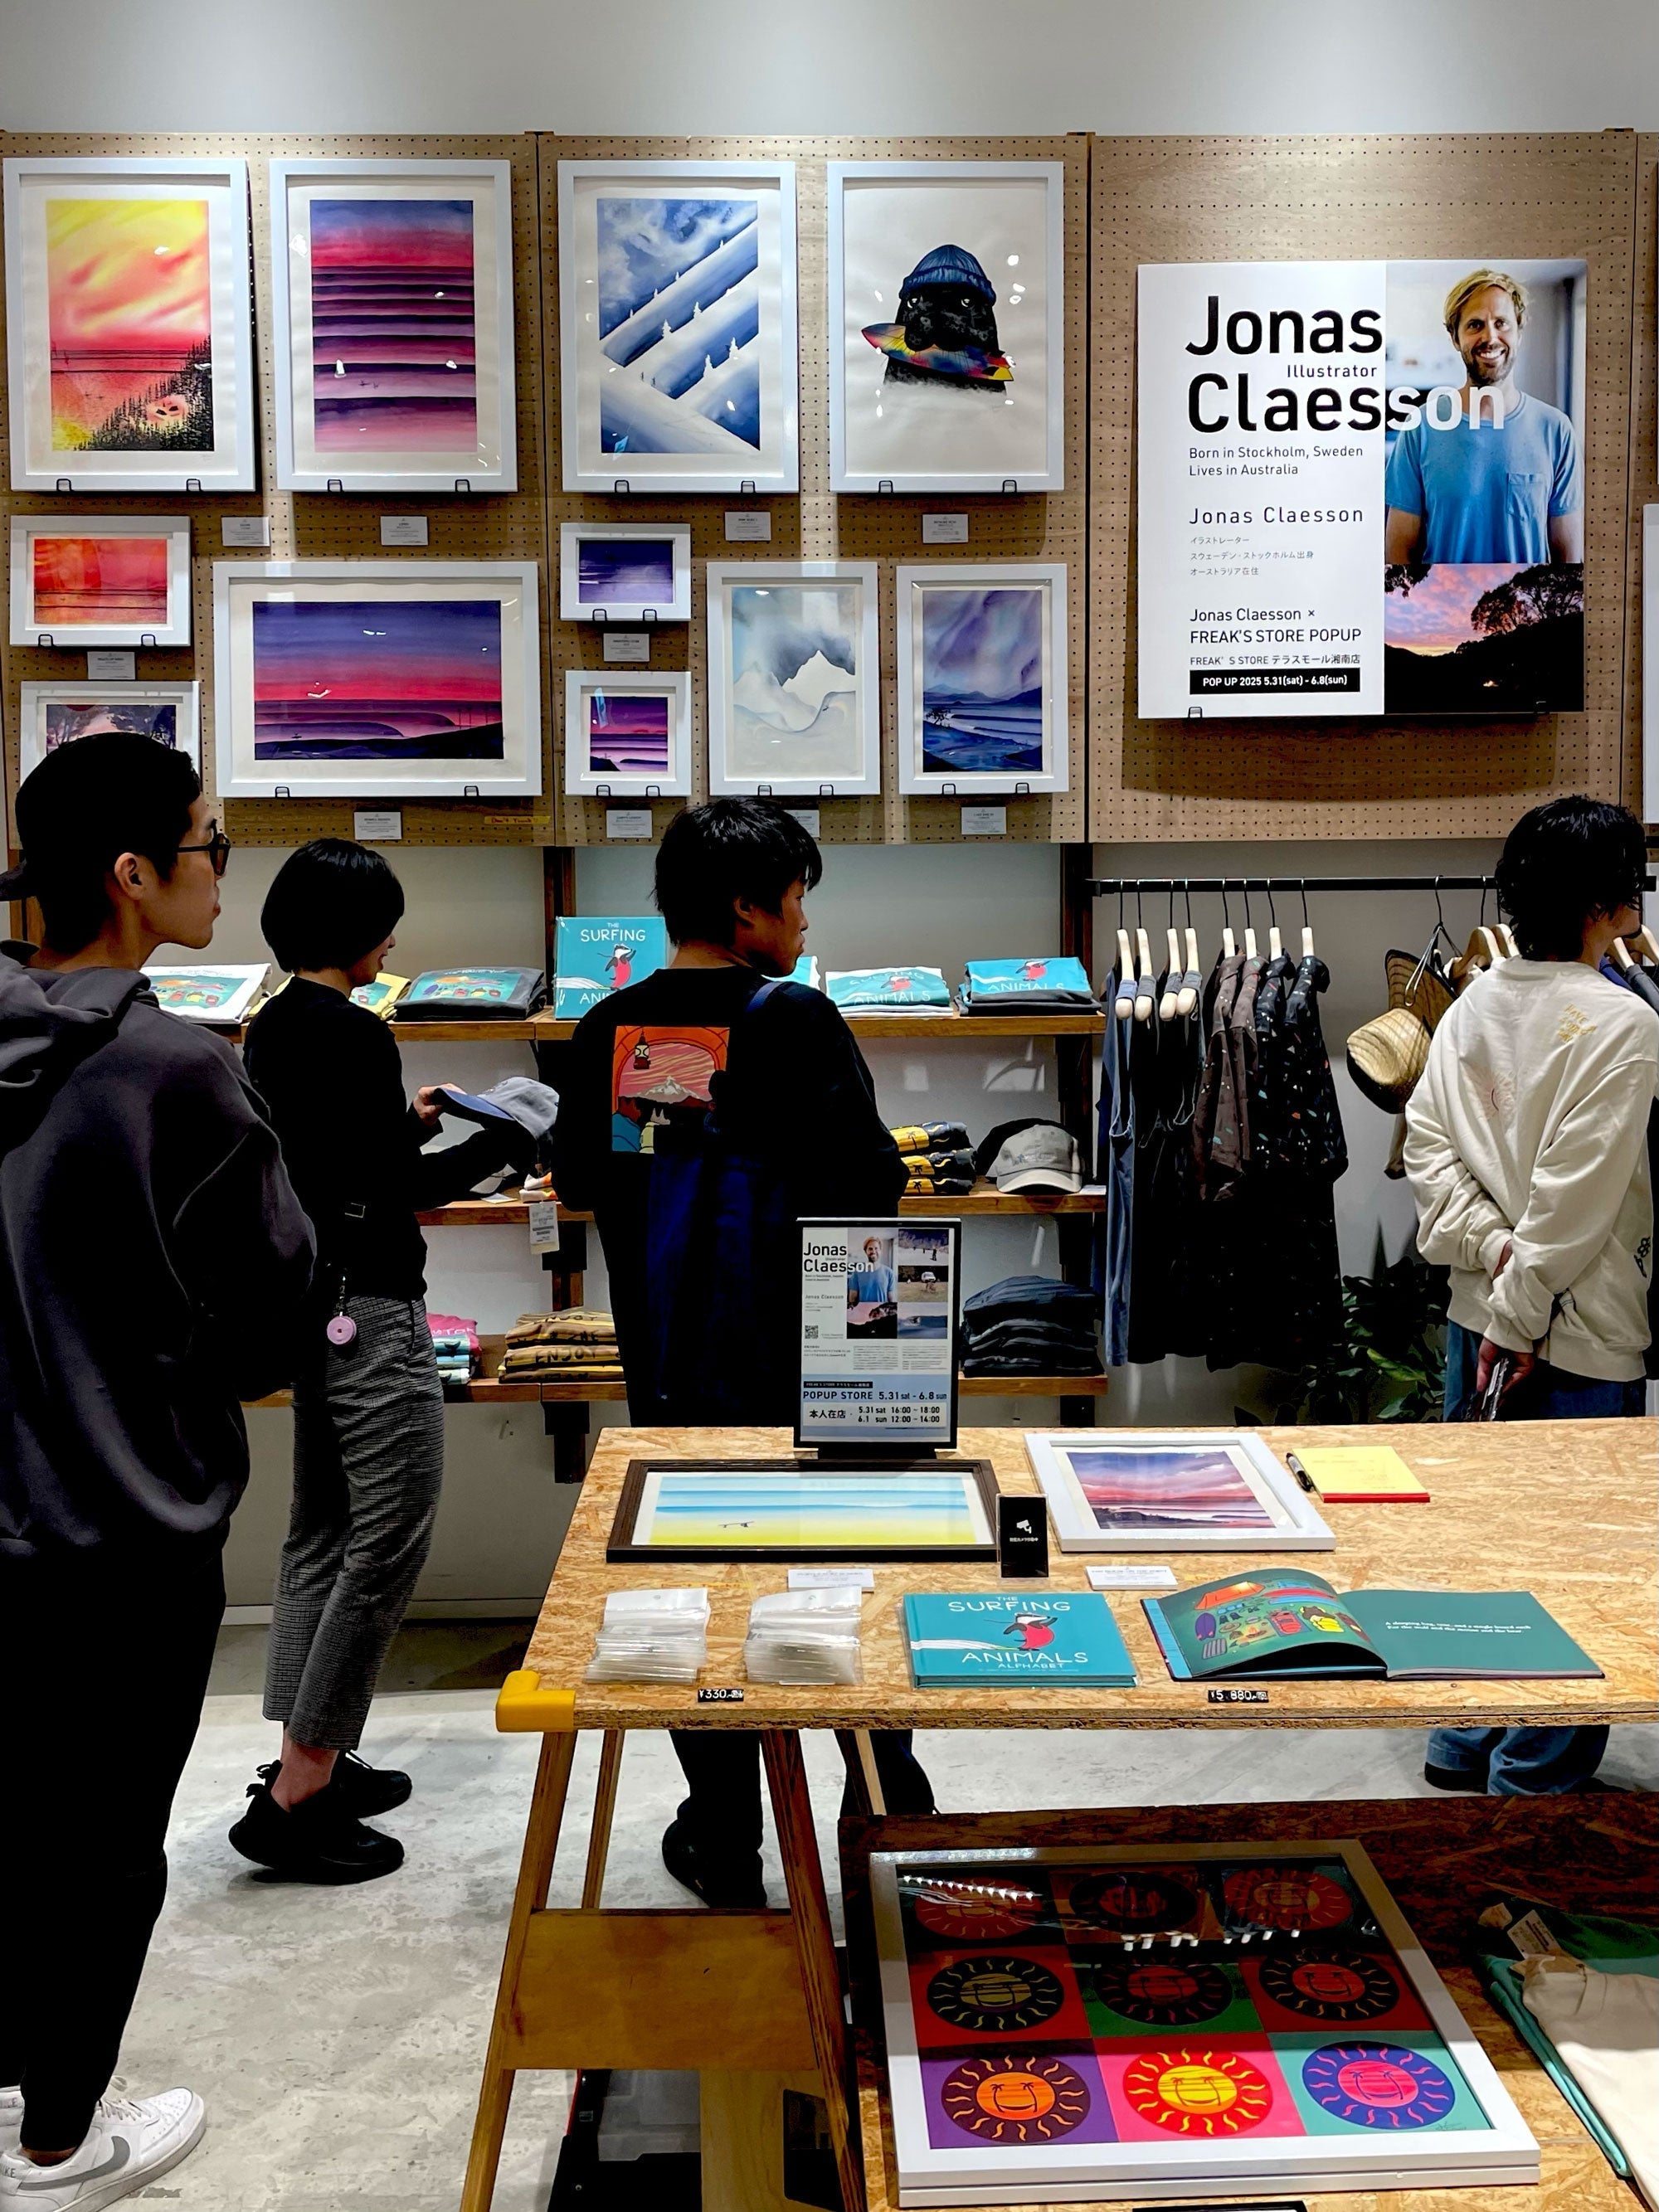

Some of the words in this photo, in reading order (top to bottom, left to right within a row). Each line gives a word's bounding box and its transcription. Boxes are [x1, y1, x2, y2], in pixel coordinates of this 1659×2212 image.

[1185, 295, 1383, 356] Jonas
[1287, 365, 1377, 378] Illustrator
[1188, 372, 1505, 433] Claesson
[1190, 448, 1219, 459] Born
[1224, 447, 1234, 458] in
[1238, 446, 1309, 459] Stockholm,
[1313, 445, 1363, 457] Sweden
[1190, 464, 1223, 476] Lives
[1226, 464, 1237, 475] in
[1240, 464, 1298, 475] Australia
[1189, 508, 1253, 524] Jonas
[1263, 507, 1363, 523] Claesson
[1190, 537, 1250, 545] イラストレーター
[1190, 566, 1259, 576] オーストラリア在住
[1190, 609, 1232, 622] Jonas
[1236, 608, 1301, 621] Claesson
[1190, 630, 1253, 644] FREAK'S
[1256, 629, 1305, 643] STORE
[1310, 628, 1361, 642] POPUP
[1238, 655, 1268, 664] STORE
[1272, 654, 1360, 664] テラスモール湘南店
[1203, 677, 1222, 687] POP
[1224, 677, 1238, 686] UP
[1239, 676, 1262, 686] 2025
[1264, 675, 1303, 687] 5.31(sat)
[1311, 674, 1347, 686] 6.8(sun)
[581, 929, 646, 942] SURFING
[803, 1242, 847, 1256] Jonas
[803, 1259, 874, 1272] Claesson
[803, 1391, 838, 1399] POPUP
[841, 1391, 873, 1400] STORE
[878, 1392, 899, 1400] 5.31
[919, 1392, 934, 1400] 6.8
[947, 1601, 1071, 1612] SURFING
[961, 1651, 1089, 1664] ANIMALS
